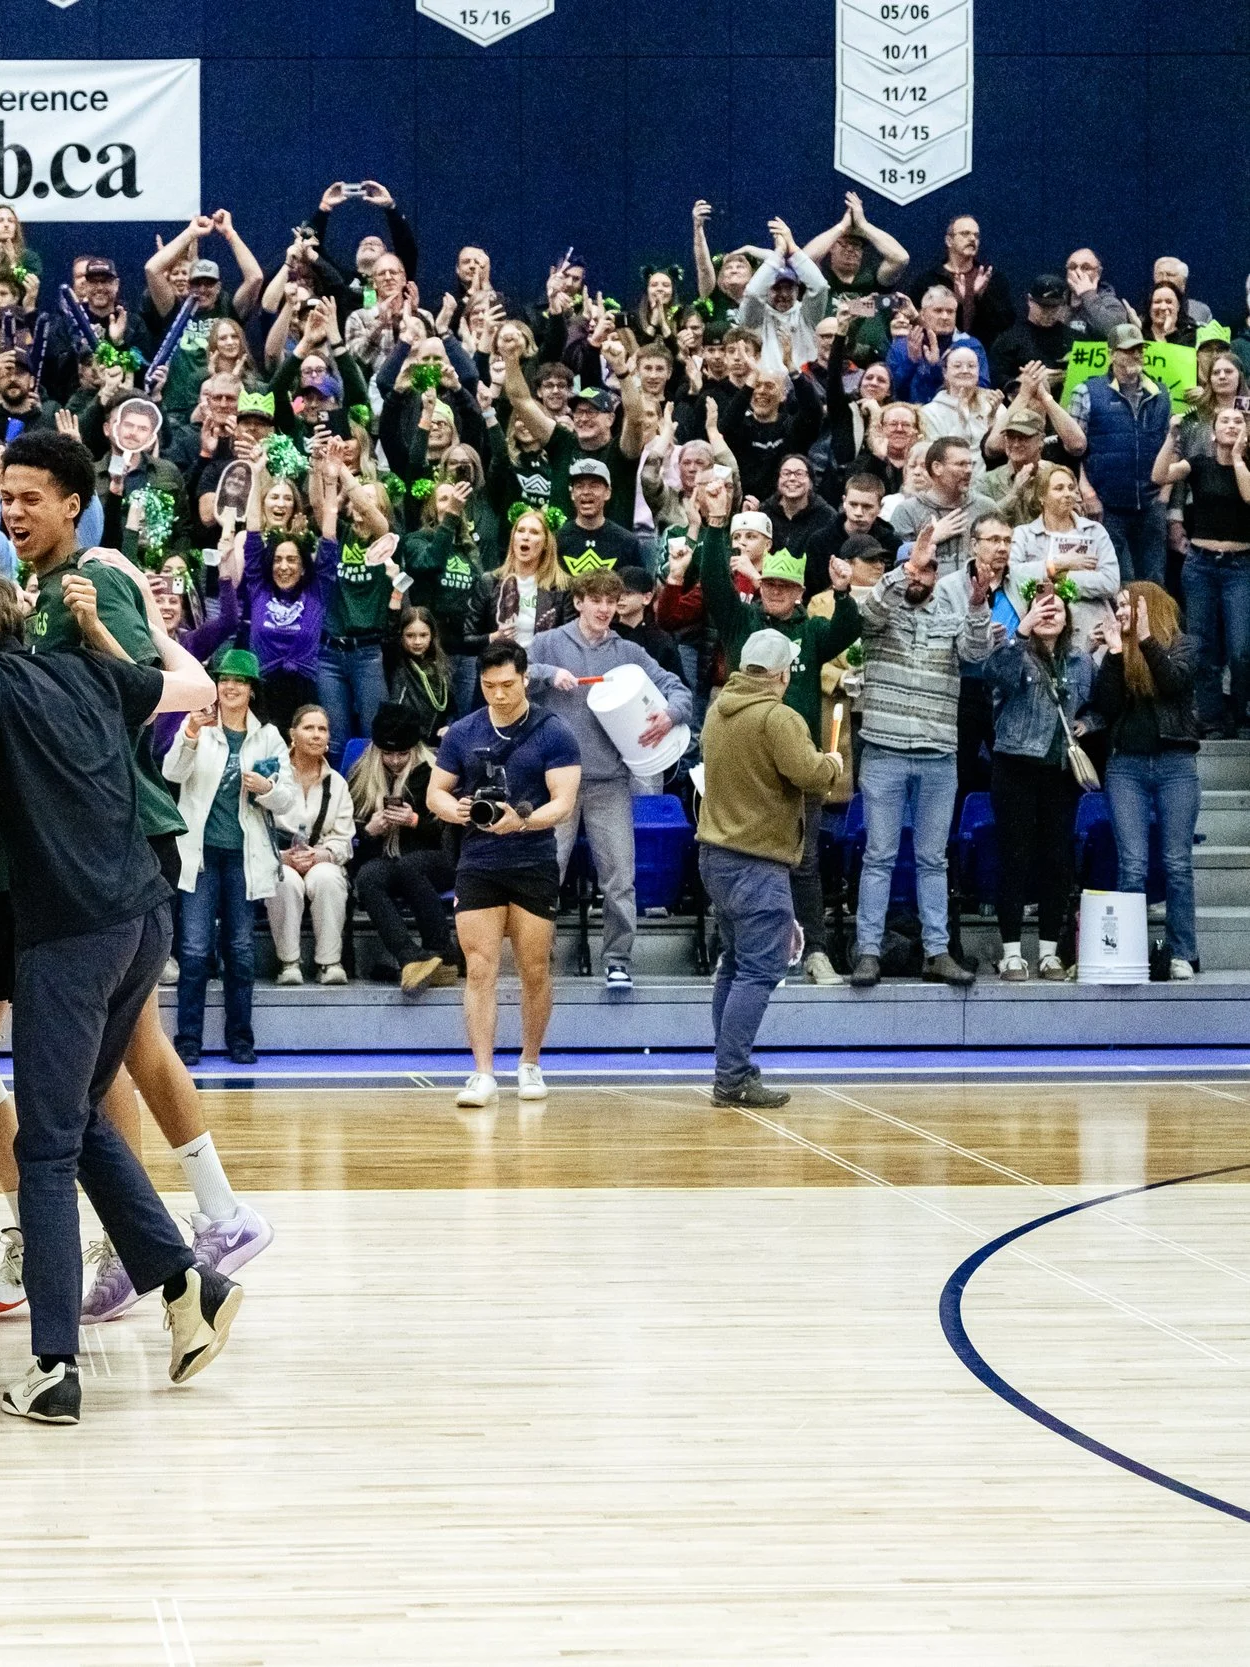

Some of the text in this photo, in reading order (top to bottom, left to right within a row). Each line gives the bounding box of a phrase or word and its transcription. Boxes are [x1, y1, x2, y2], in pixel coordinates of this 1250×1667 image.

[459, 10, 512, 25] 15/16
[881, 4, 930, 20] 05/06
[882, 44, 928, 59] 10/11
[882, 86, 927, 102] 11/12
[879, 125, 930, 141] 14/15
[879, 169, 926, 184] 18-19
[1072, 348, 1107, 368] #15
